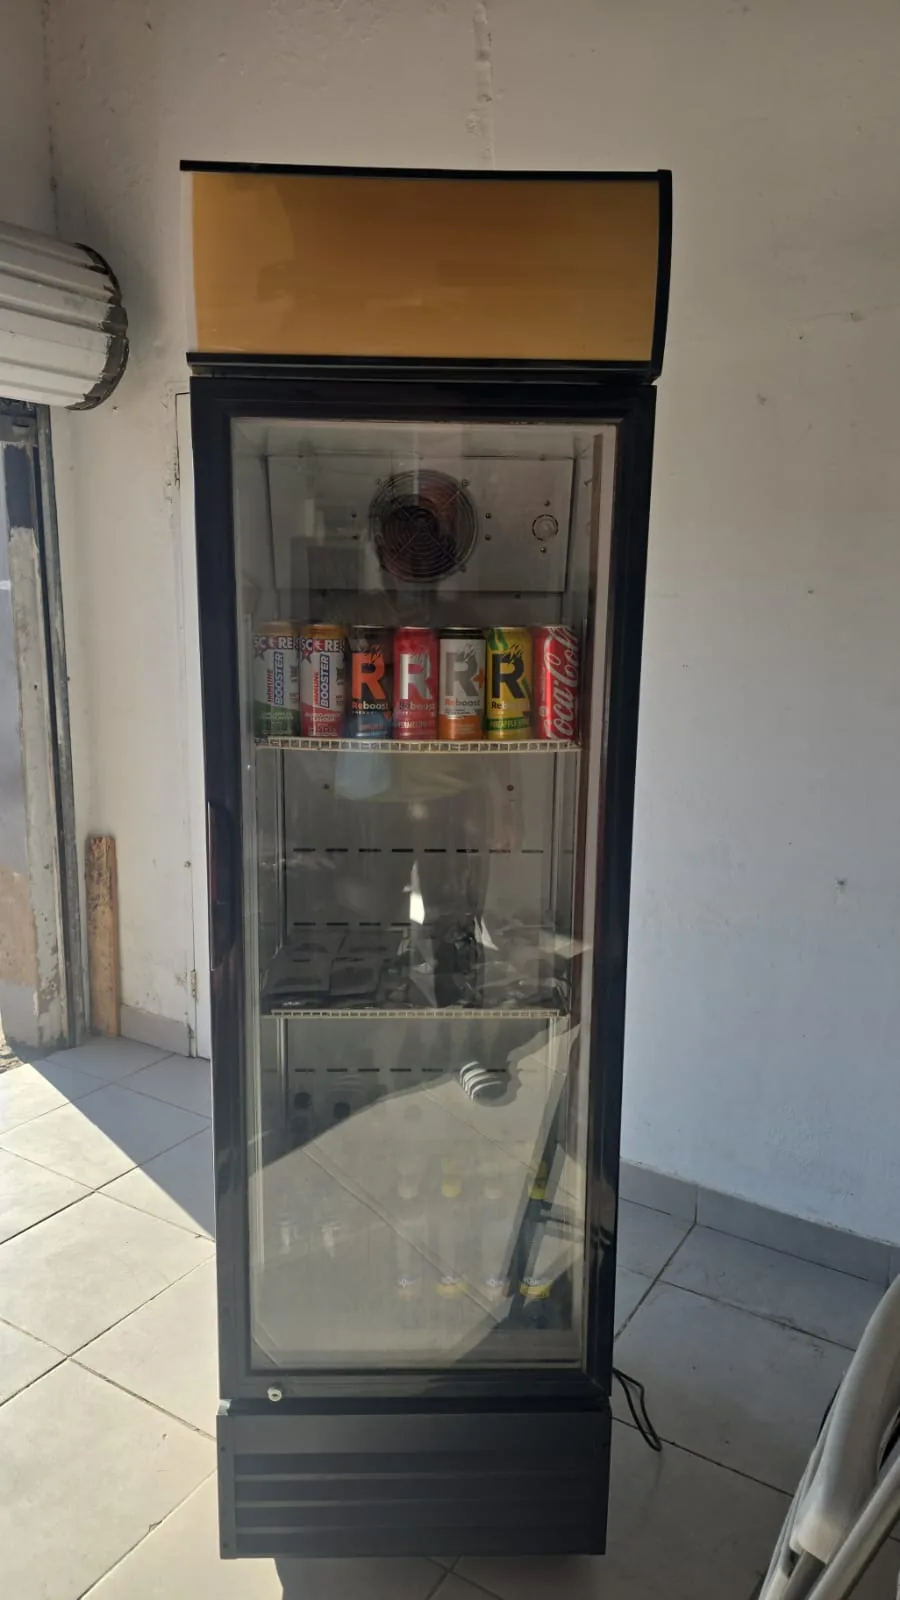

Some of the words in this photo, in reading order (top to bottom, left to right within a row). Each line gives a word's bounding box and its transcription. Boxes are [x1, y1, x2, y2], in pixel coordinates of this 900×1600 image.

[274, 652, 283, 705] BOOSTER
[320, 655, 329, 708] BOOSTER
[352, 652, 386, 699] R
[400, 653, 433, 699] R
[446, 652, 480, 697] R
[492, 653, 526, 699] R
[352, 700, 388, 710] Reboost
